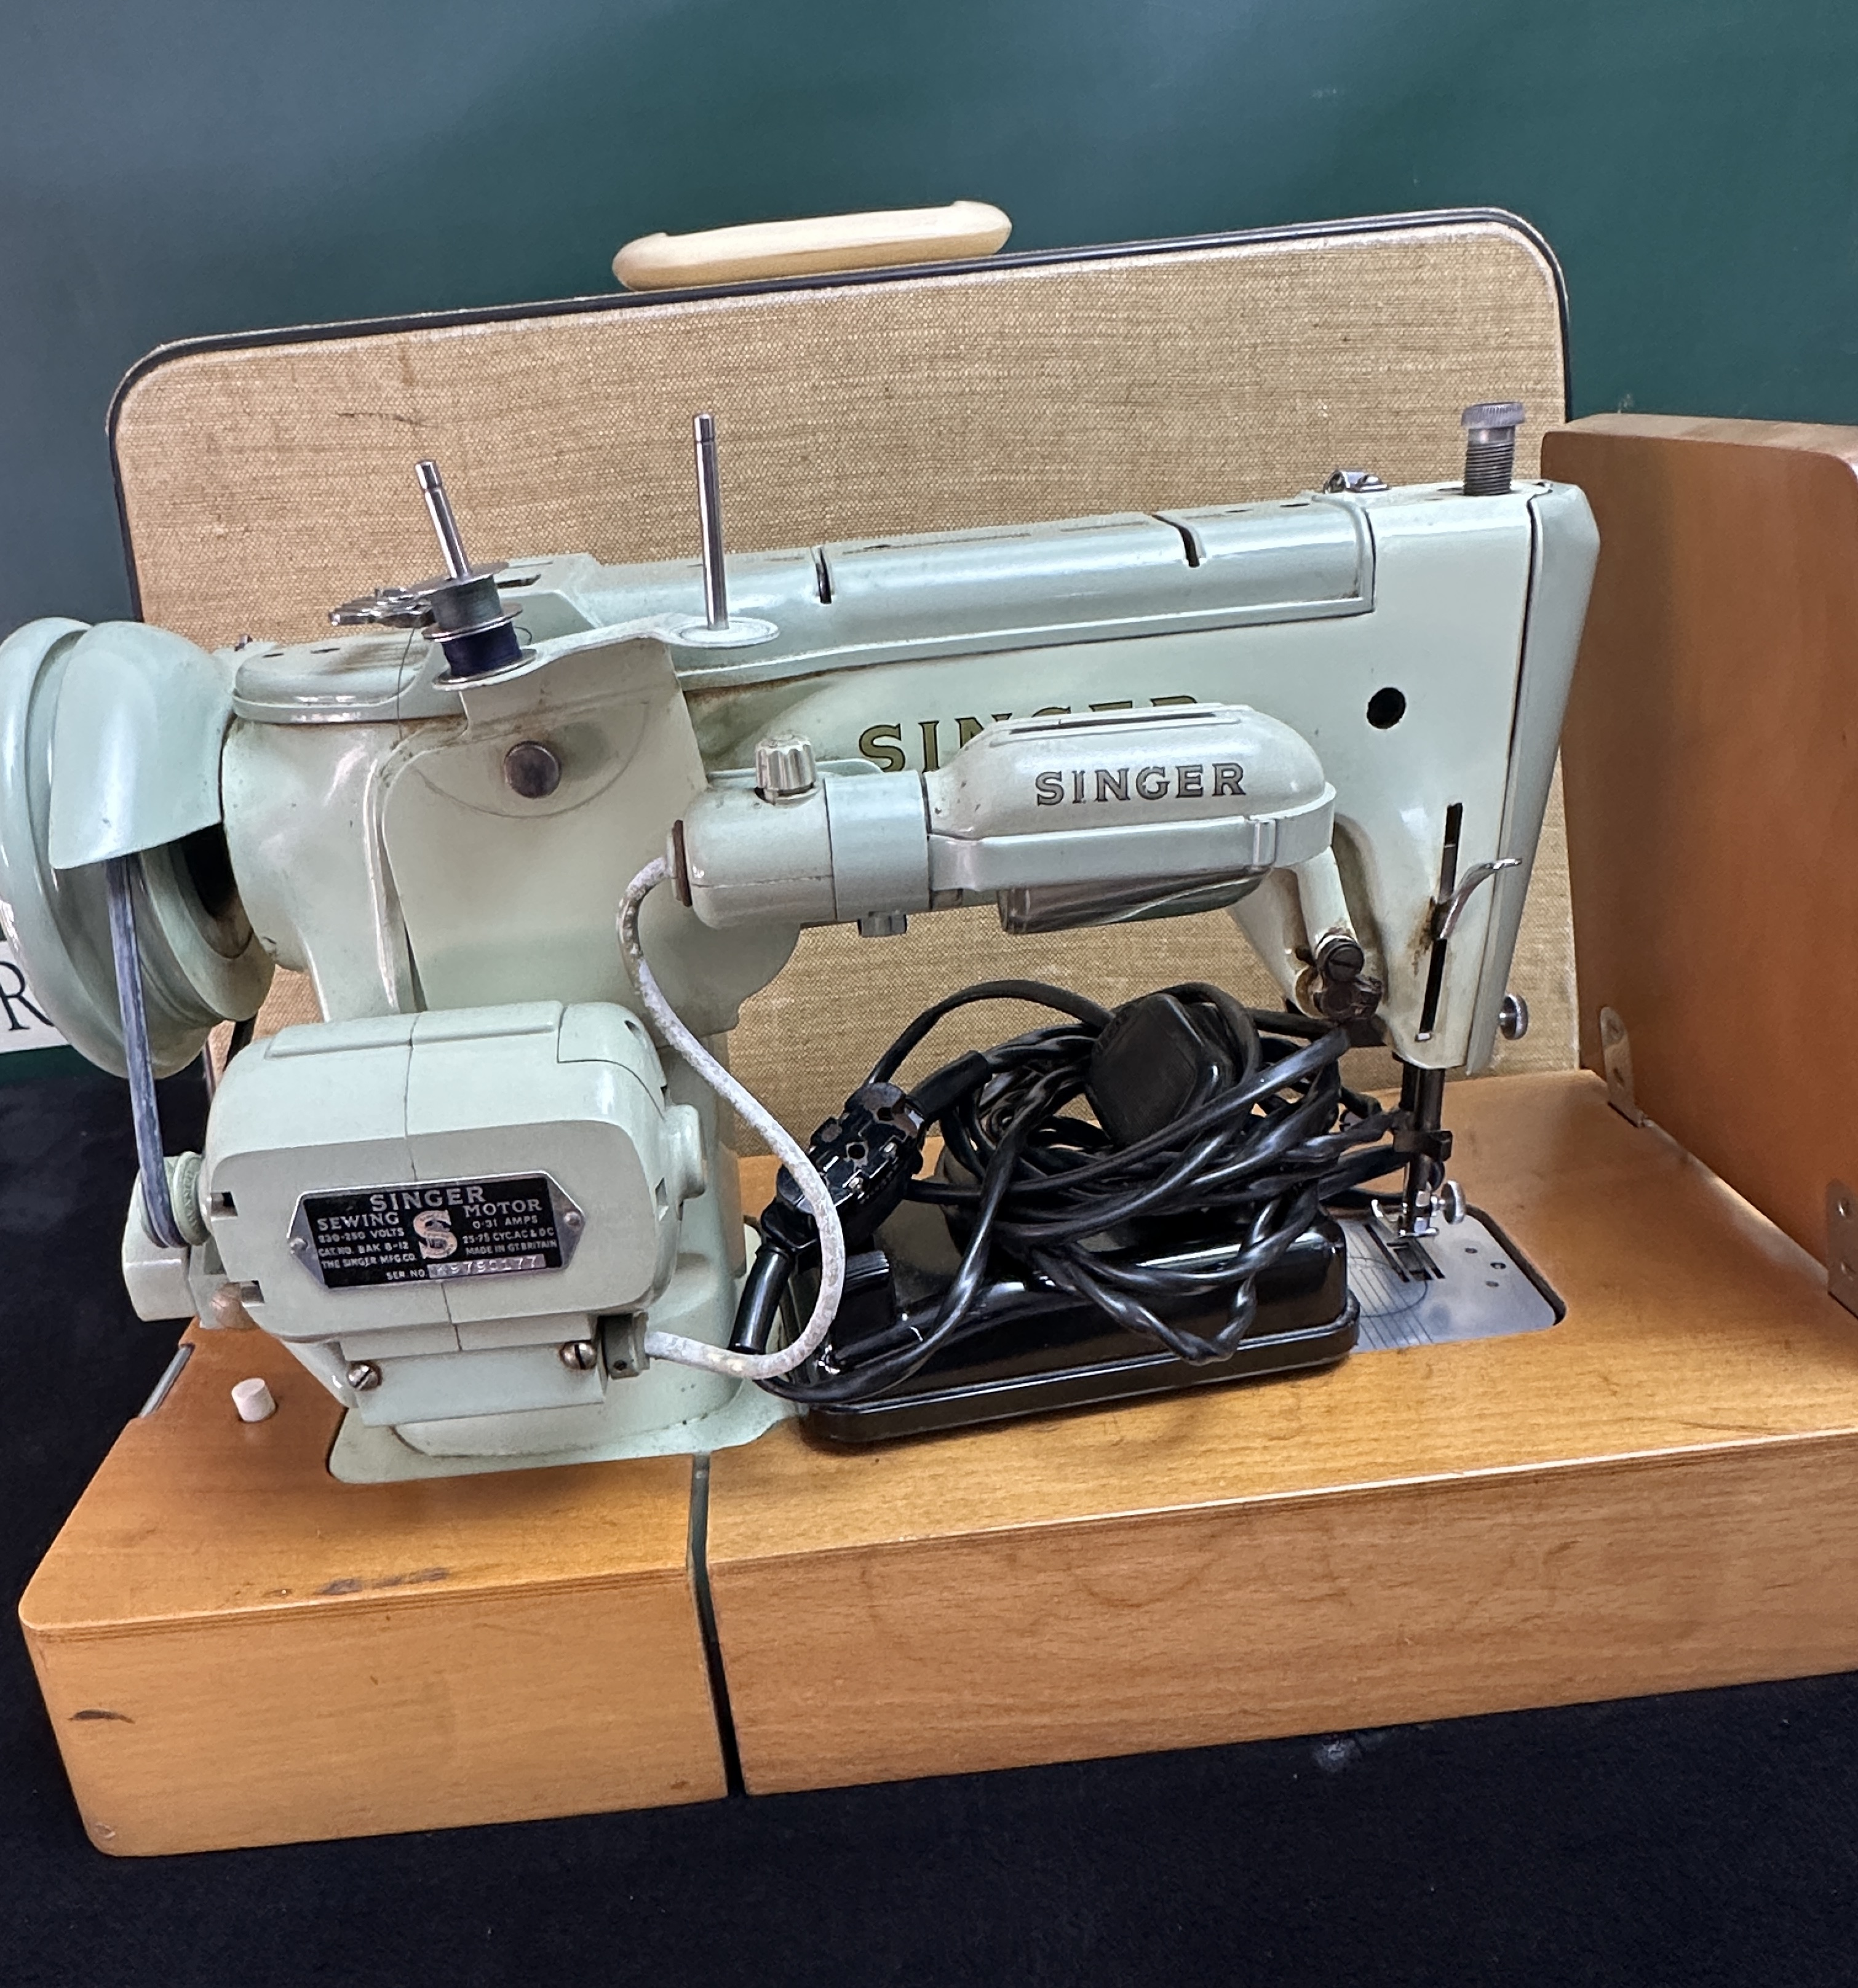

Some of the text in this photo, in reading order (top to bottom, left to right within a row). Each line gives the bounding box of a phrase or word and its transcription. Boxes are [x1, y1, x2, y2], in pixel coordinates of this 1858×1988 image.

[1035, 763, 1246, 806] SINGER
[370, 1186, 486, 1212] SINGER
[317, 1199, 542, 1231] SEWING MOTOR
[505, 1215, 538, 1226] AMPS
[370, 1228, 405, 1239] VOLTS
